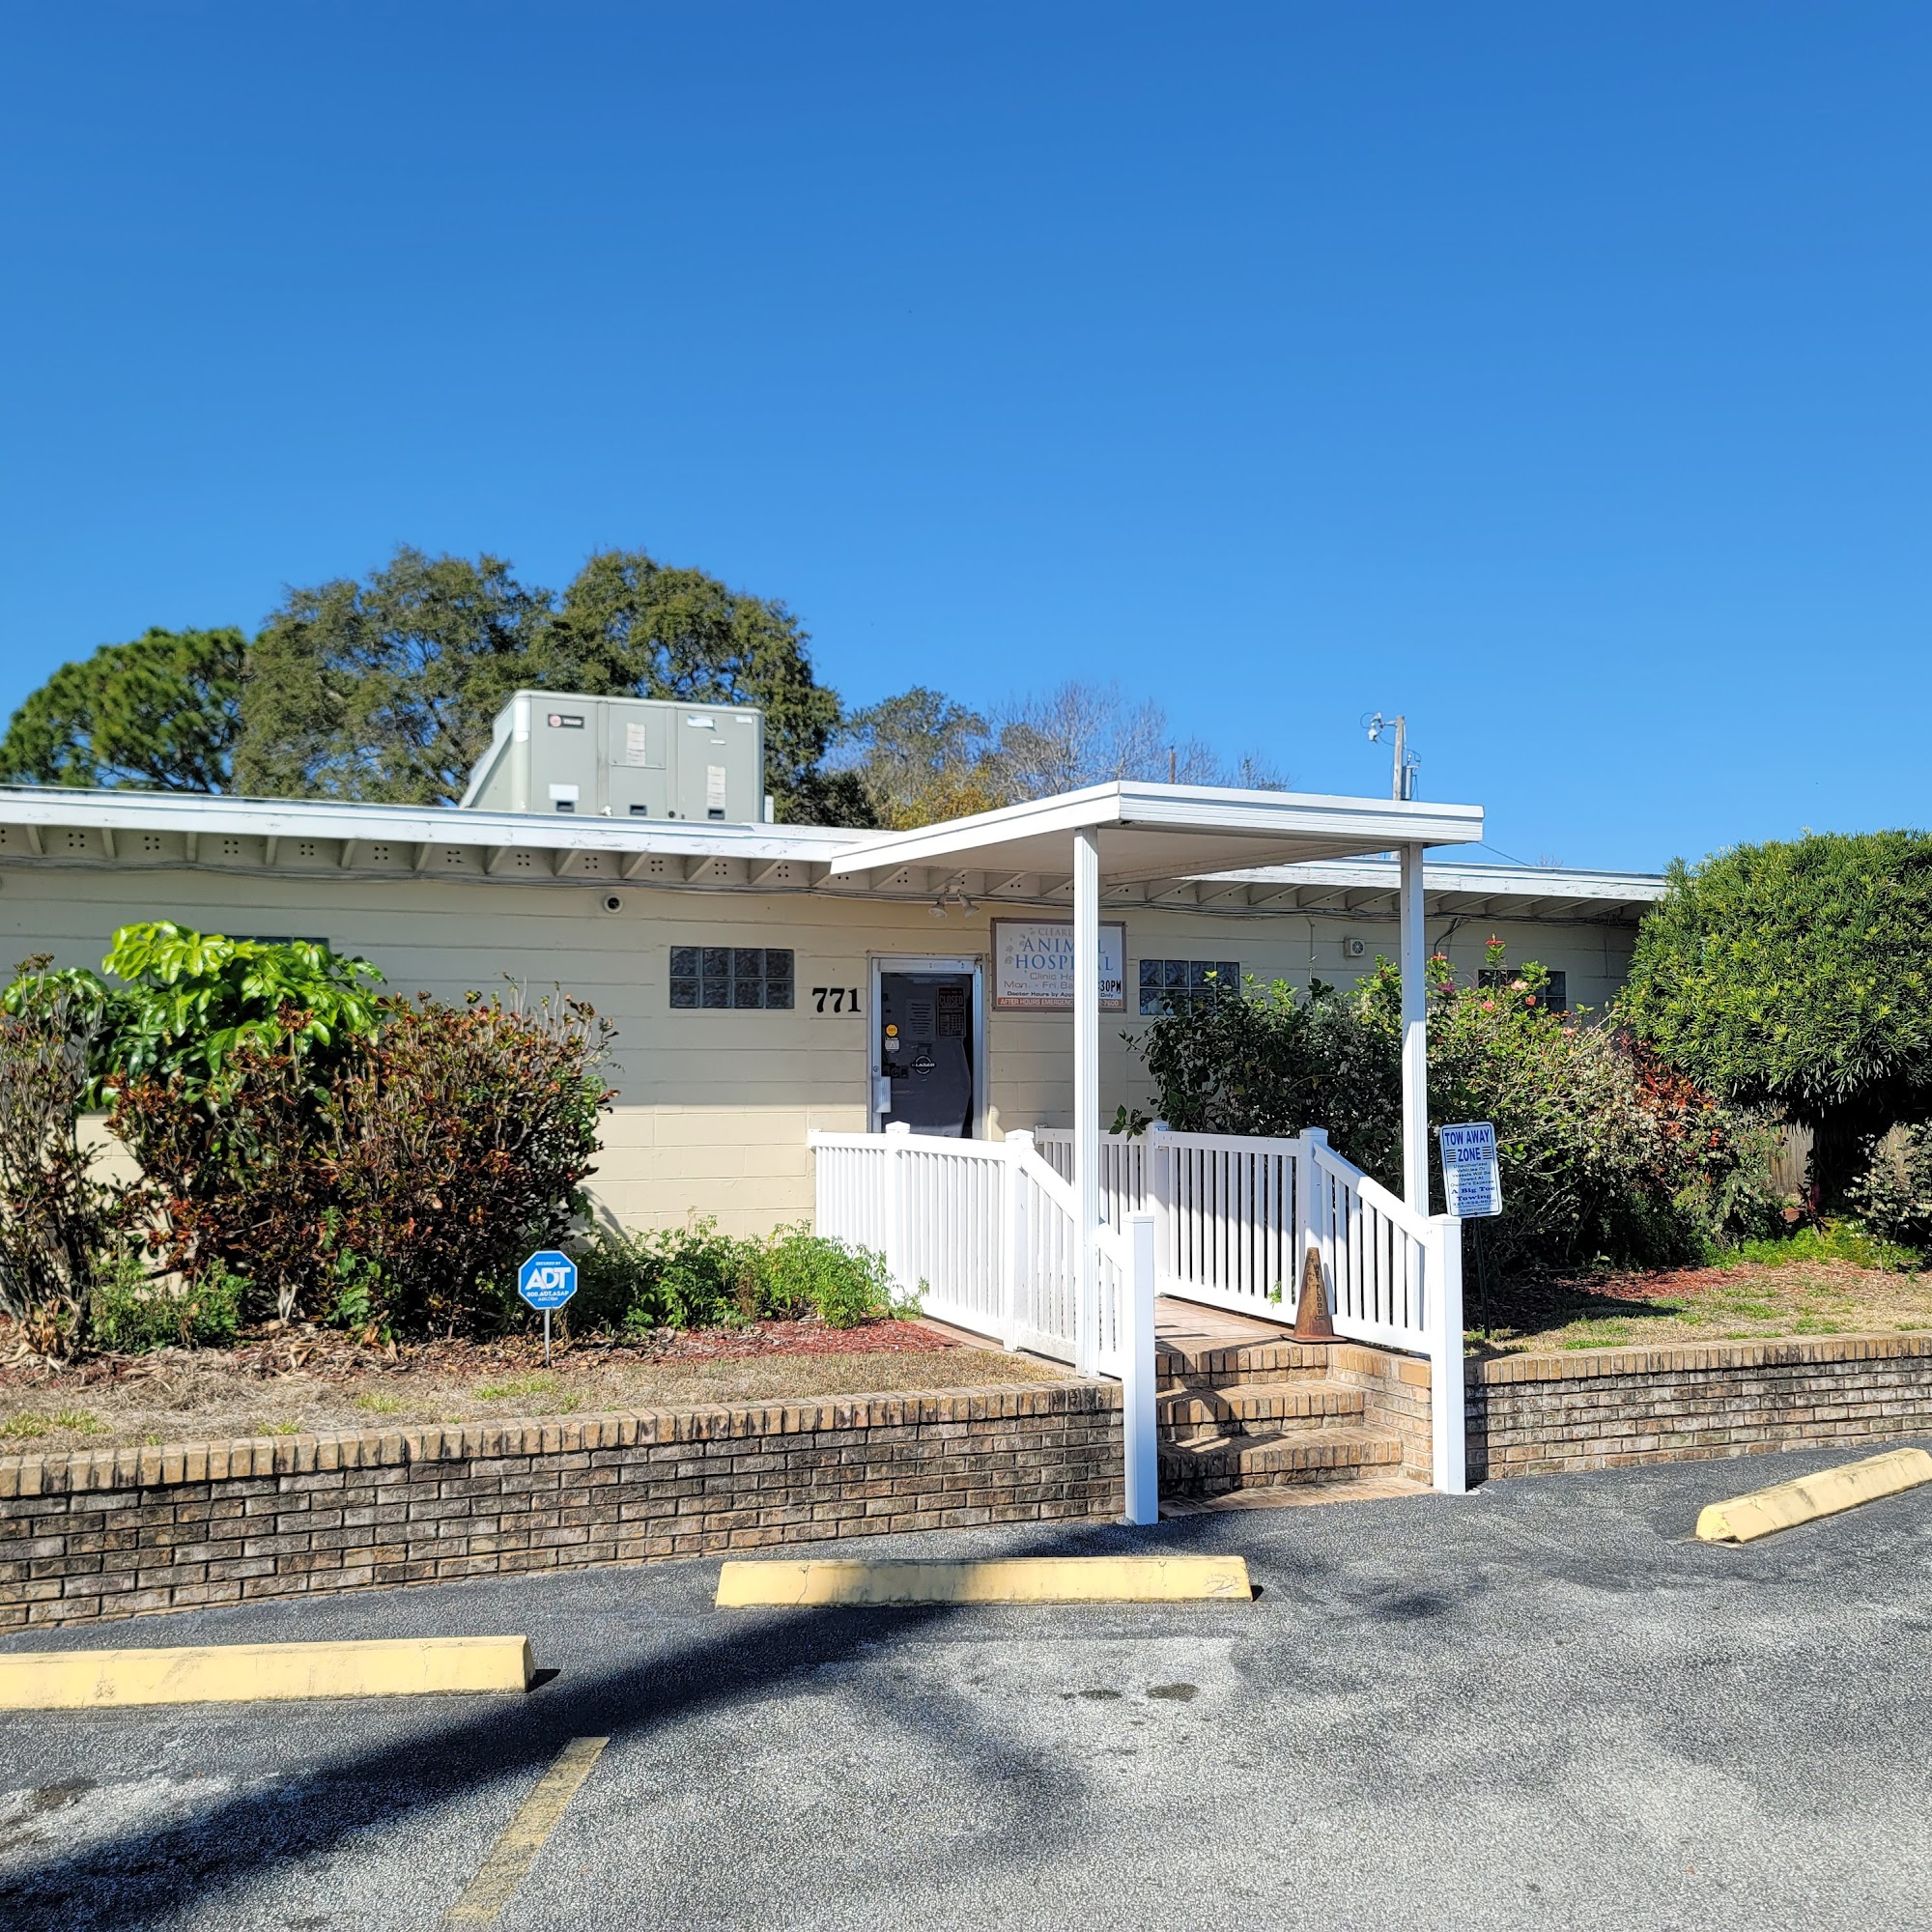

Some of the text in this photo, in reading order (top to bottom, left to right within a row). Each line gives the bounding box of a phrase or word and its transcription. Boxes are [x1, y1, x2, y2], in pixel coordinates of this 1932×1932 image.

[1037, 927, 1073, 937] CLEARL
[1022, 937, 1106, 953] ANIML
[1015, 954, 1114, 971] HOSPIL
[1030, 972, 1057, 980] Clinic
[1004, 980, 1031, 989] Mon.
[811, 987, 862, 1013] 771
[939, 995, 964, 1005] CLOSED
[1445, 1129, 1489, 1147] TOW AWAY
[1458, 1147, 1481, 1162] ZONE
[525, 1266, 572, 1291] ADT
